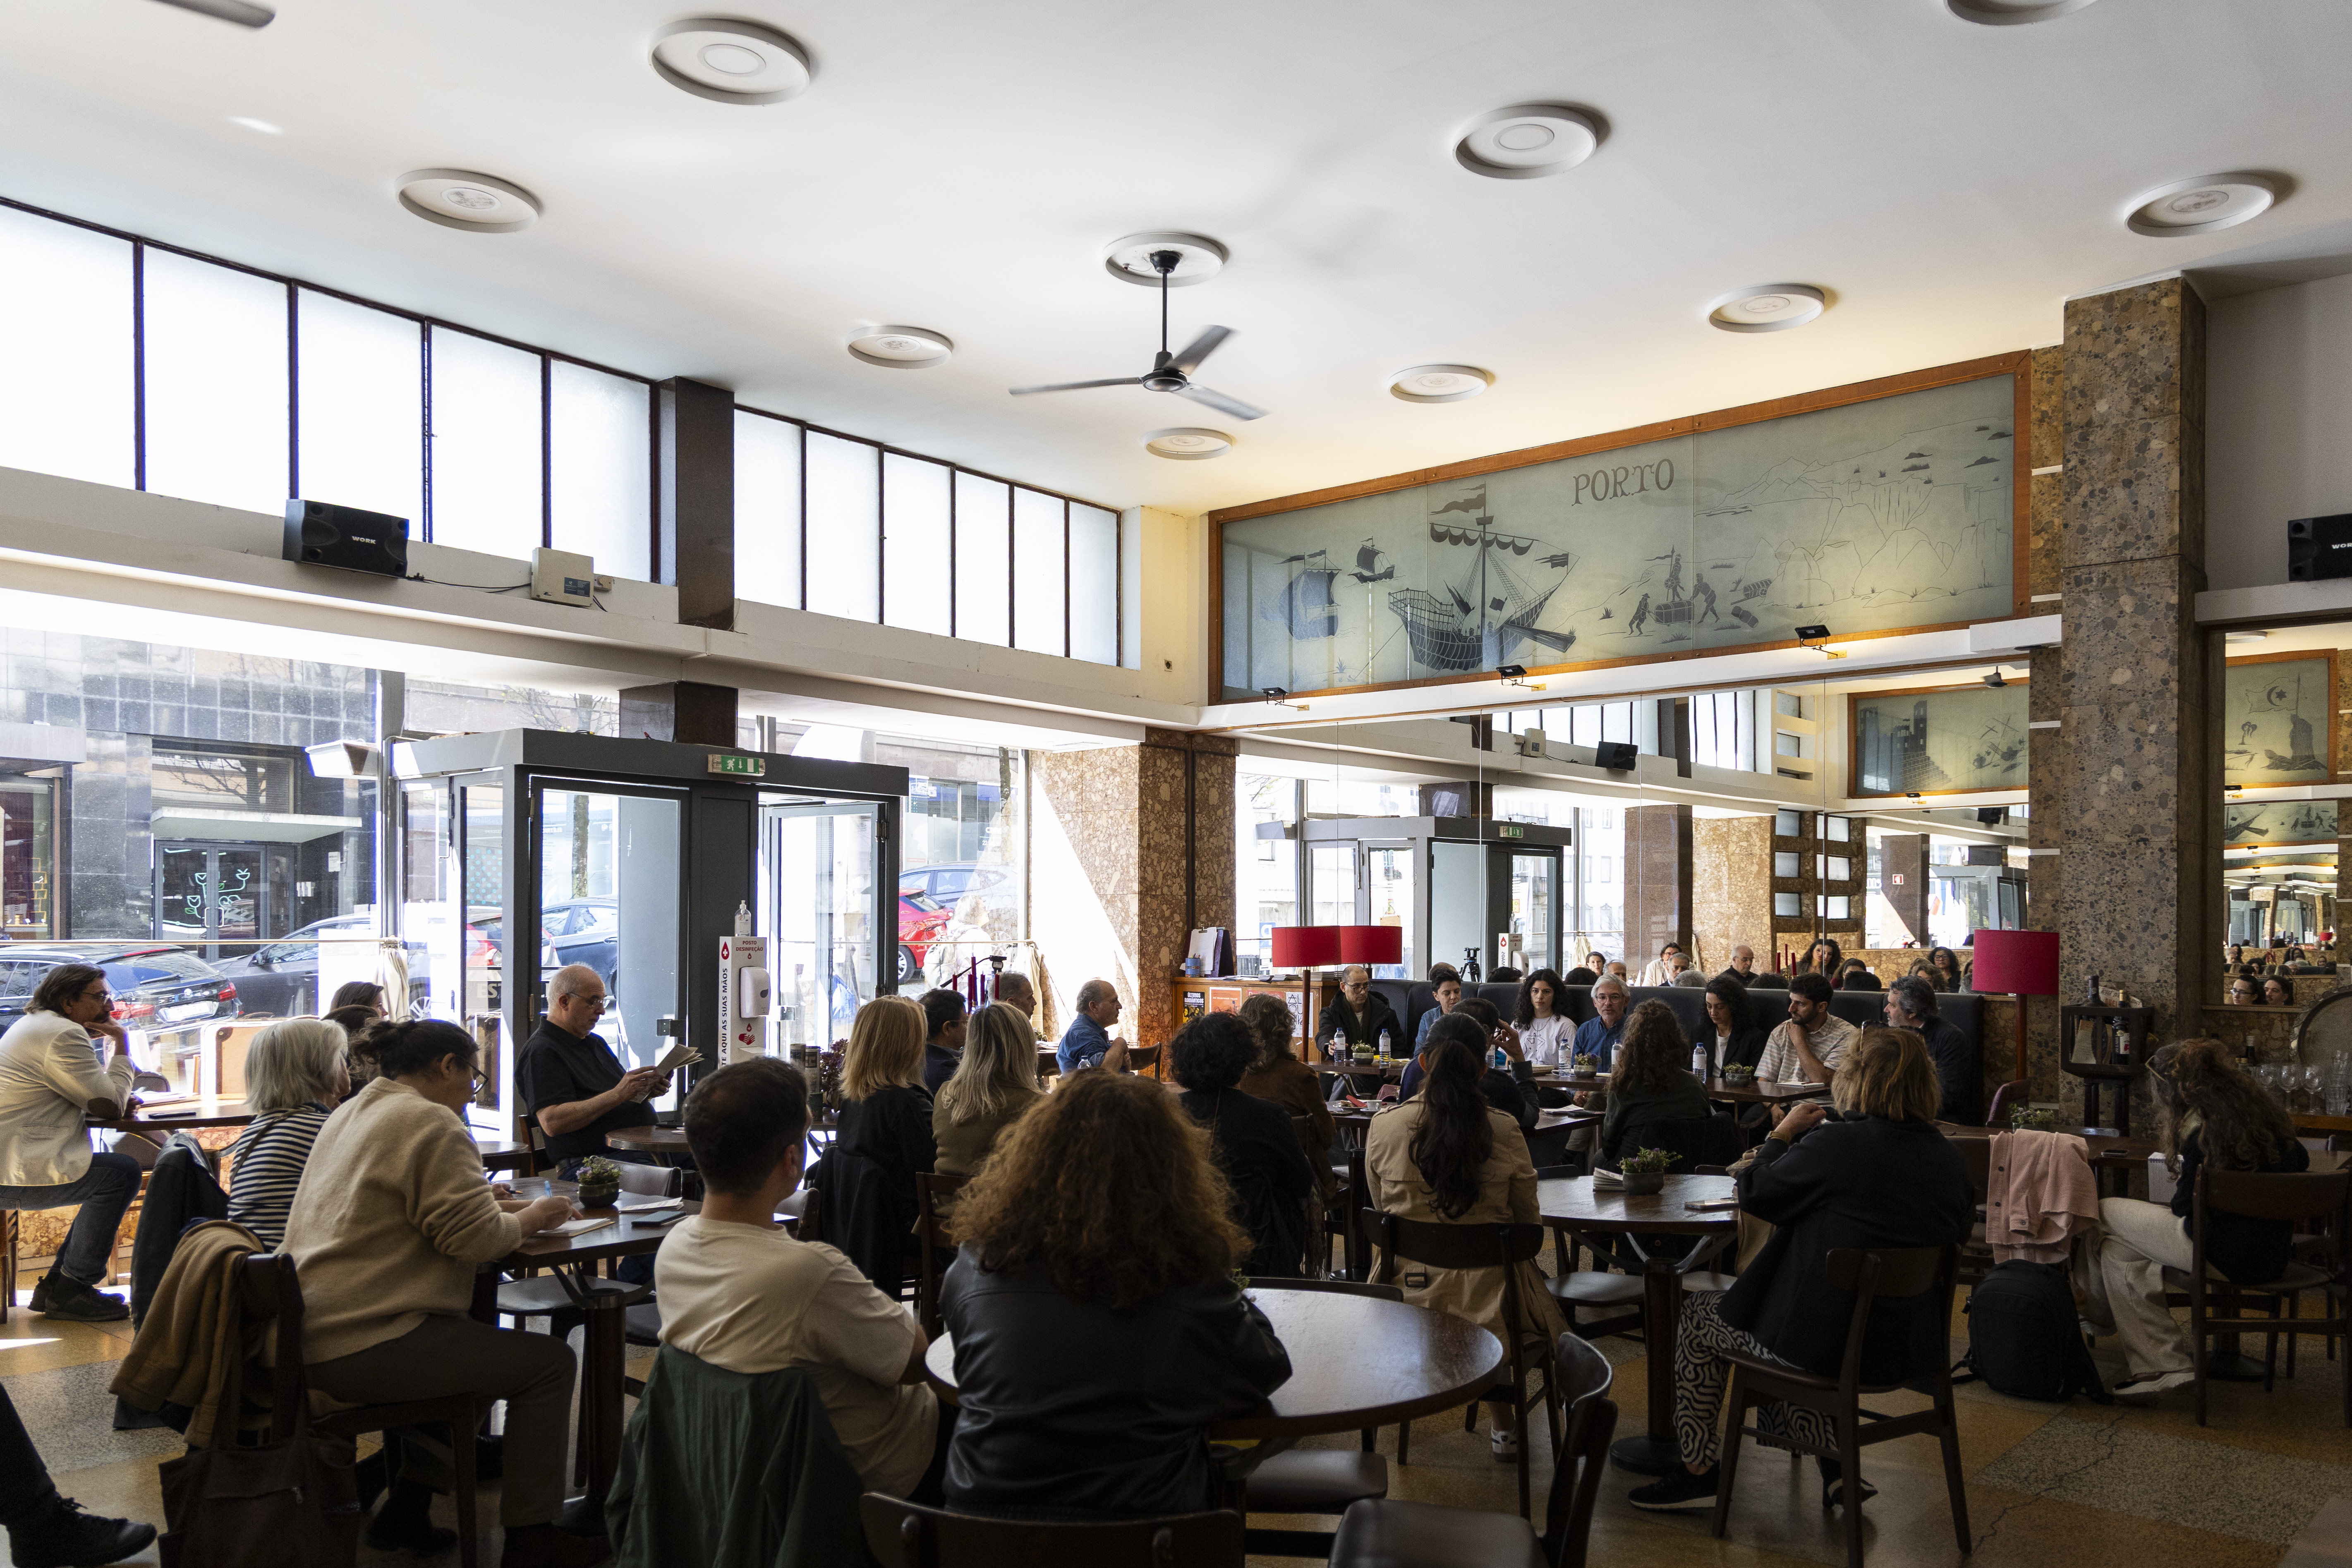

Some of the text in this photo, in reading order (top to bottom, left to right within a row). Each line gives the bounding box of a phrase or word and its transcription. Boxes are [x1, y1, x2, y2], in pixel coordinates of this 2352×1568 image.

[1571, 458, 1674, 506] PORTO
[351, 536, 376, 545] WORK
[477, 984, 502, 998] ES
[722, 1020, 727, 1030] AS
